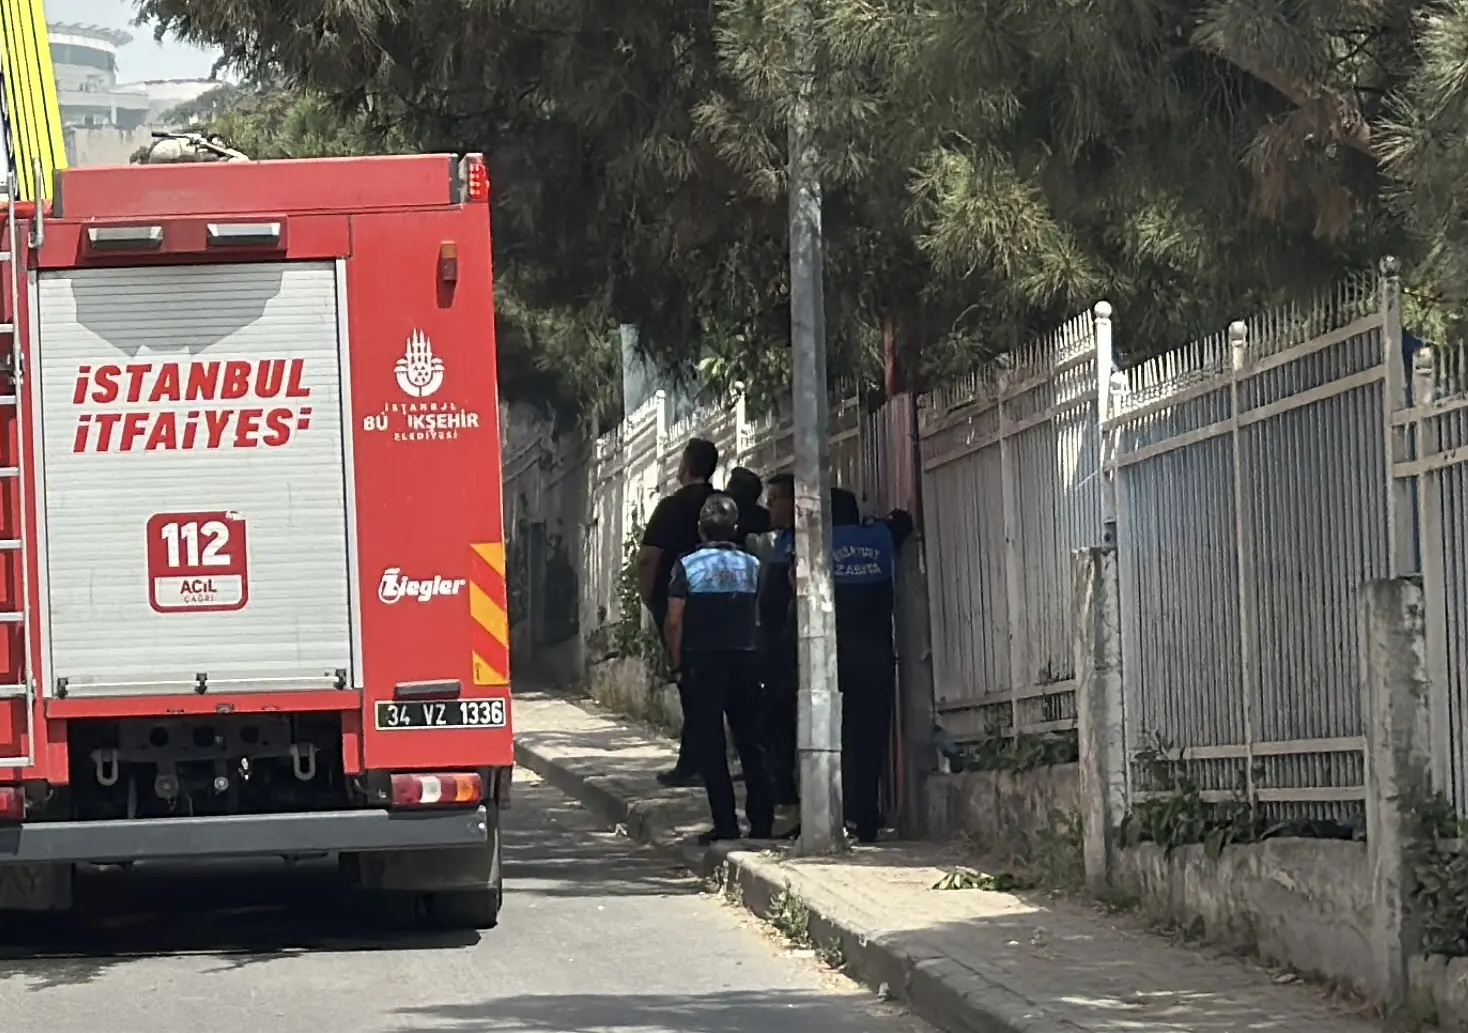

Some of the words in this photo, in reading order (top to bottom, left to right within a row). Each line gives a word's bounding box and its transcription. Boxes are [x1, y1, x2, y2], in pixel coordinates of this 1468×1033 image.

[160, 521, 231, 568] 112
[378, 568, 466, 604] Ziegler
[387, 705, 411, 725] 34
[423, 704, 447, 725] VZ
[460, 702, 502, 724] 1336
